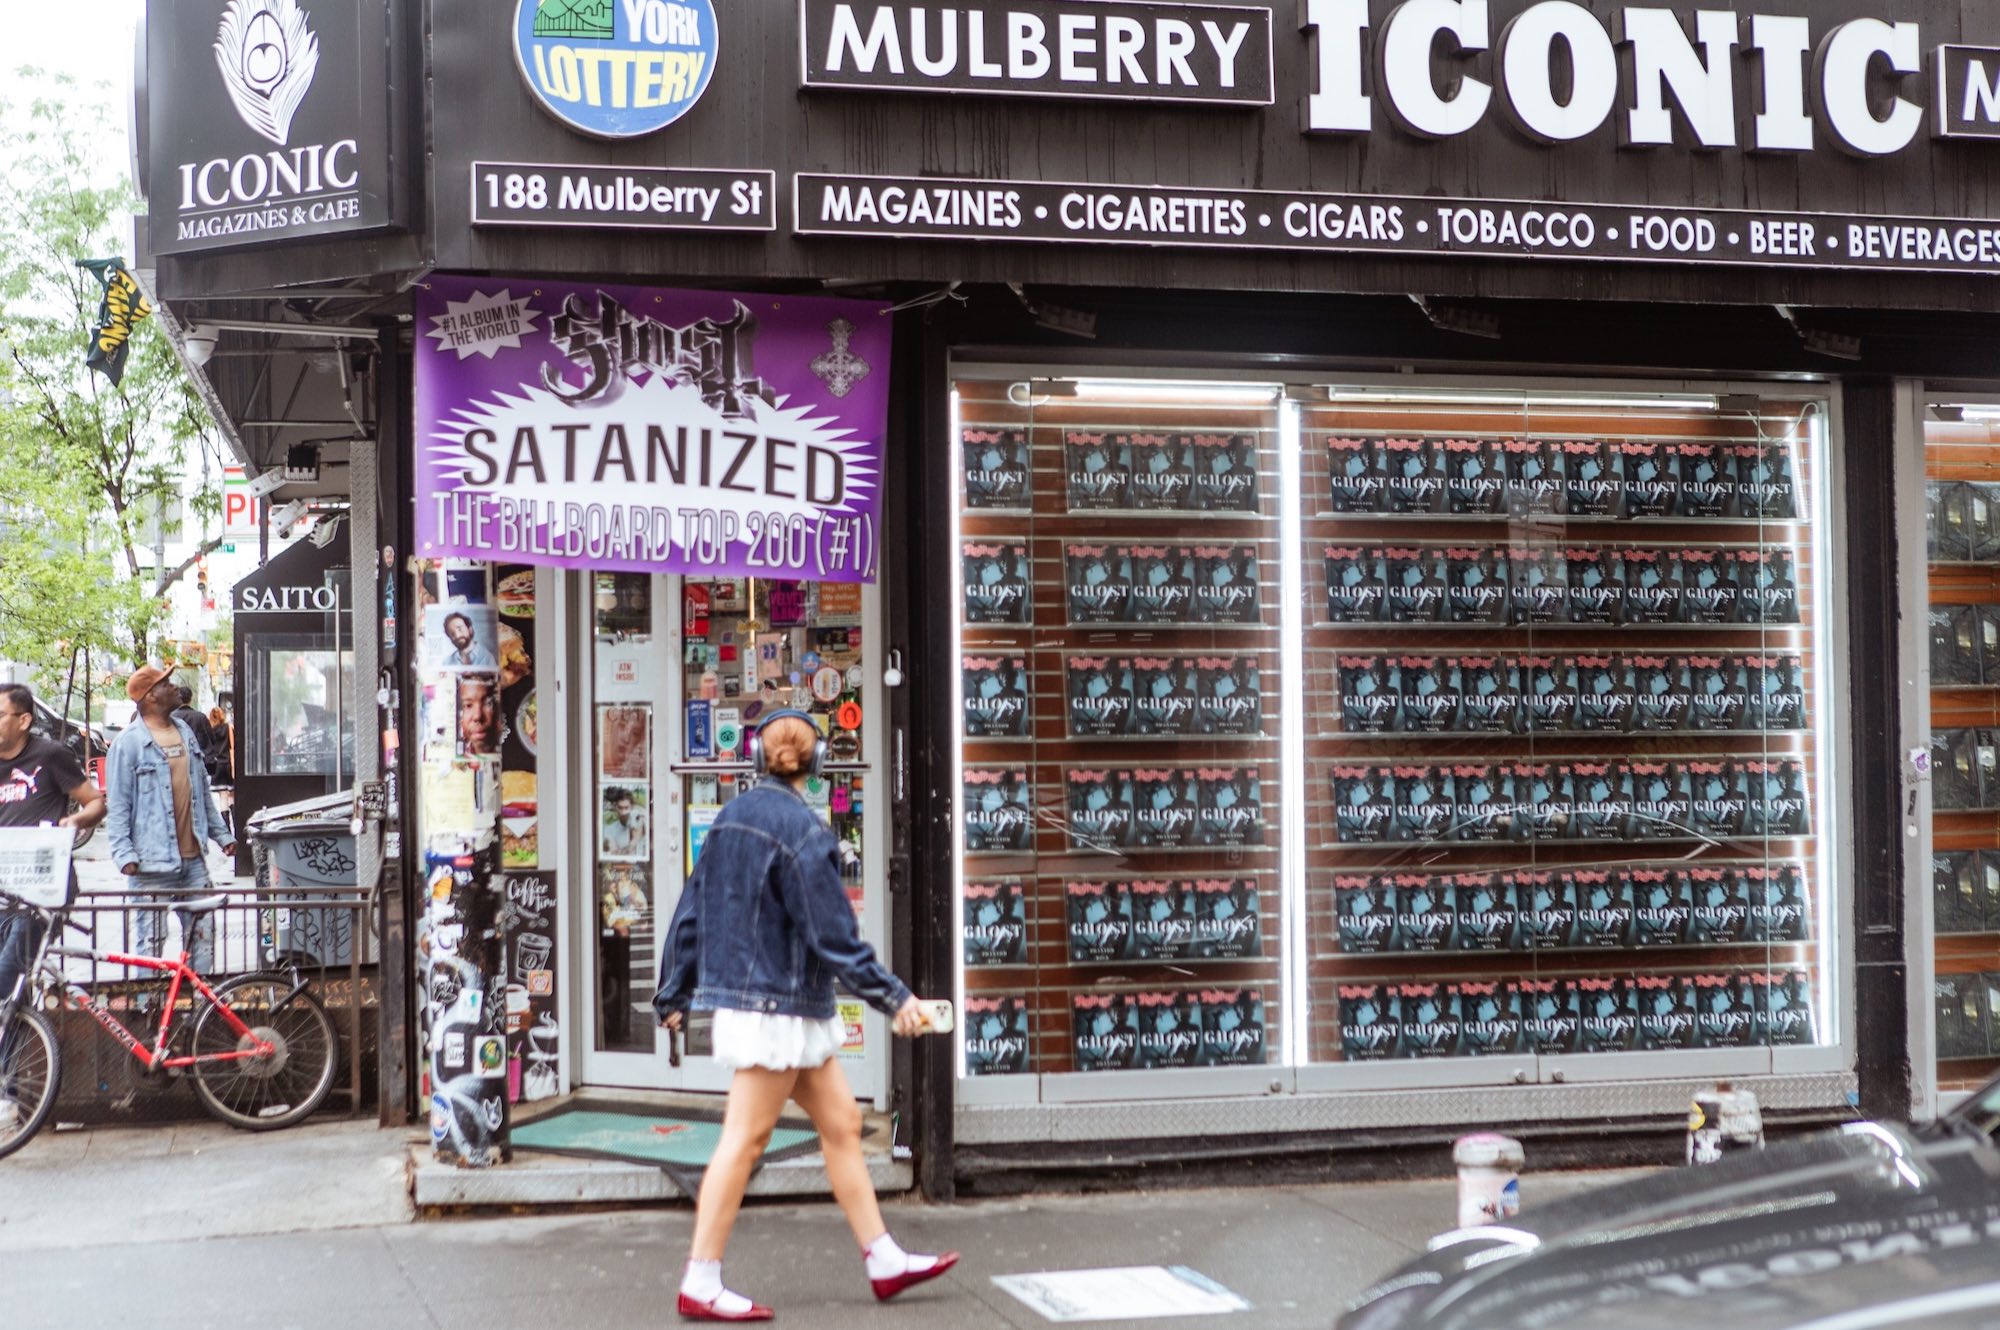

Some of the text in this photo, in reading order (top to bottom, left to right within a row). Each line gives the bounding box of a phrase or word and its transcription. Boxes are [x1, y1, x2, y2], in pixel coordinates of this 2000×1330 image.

[623, 0, 701, 46] YORK
[825, 4, 1250, 88] MULBERRY
[532, 44, 706, 109] LOTTERY
[1306, 0, 1924, 155] ICONIC
[178, 139, 359, 210] ICONIC
[484, 174, 763, 222] 188 Mulberry St
[177, 197, 360, 241] MAGAZINES & CAFE
[820, 184, 2000, 263] MAGAZINES CIGARETTES CIGARS TOBACCO FOOD BEER BEVERAGES
[442, 303, 521, 333] #1 ALBUM IN
[447, 319, 520, 347] THE WORLD
[462, 422, 847, 507] SATANIZED
[432, 491, 873, 578] THE BILLBOARD TOP 200 (#1)
[242, 586, 336, 611] SAITO
[695, 776, 716, 785] PUSH
[507, 877, 549, 907] Coffee
